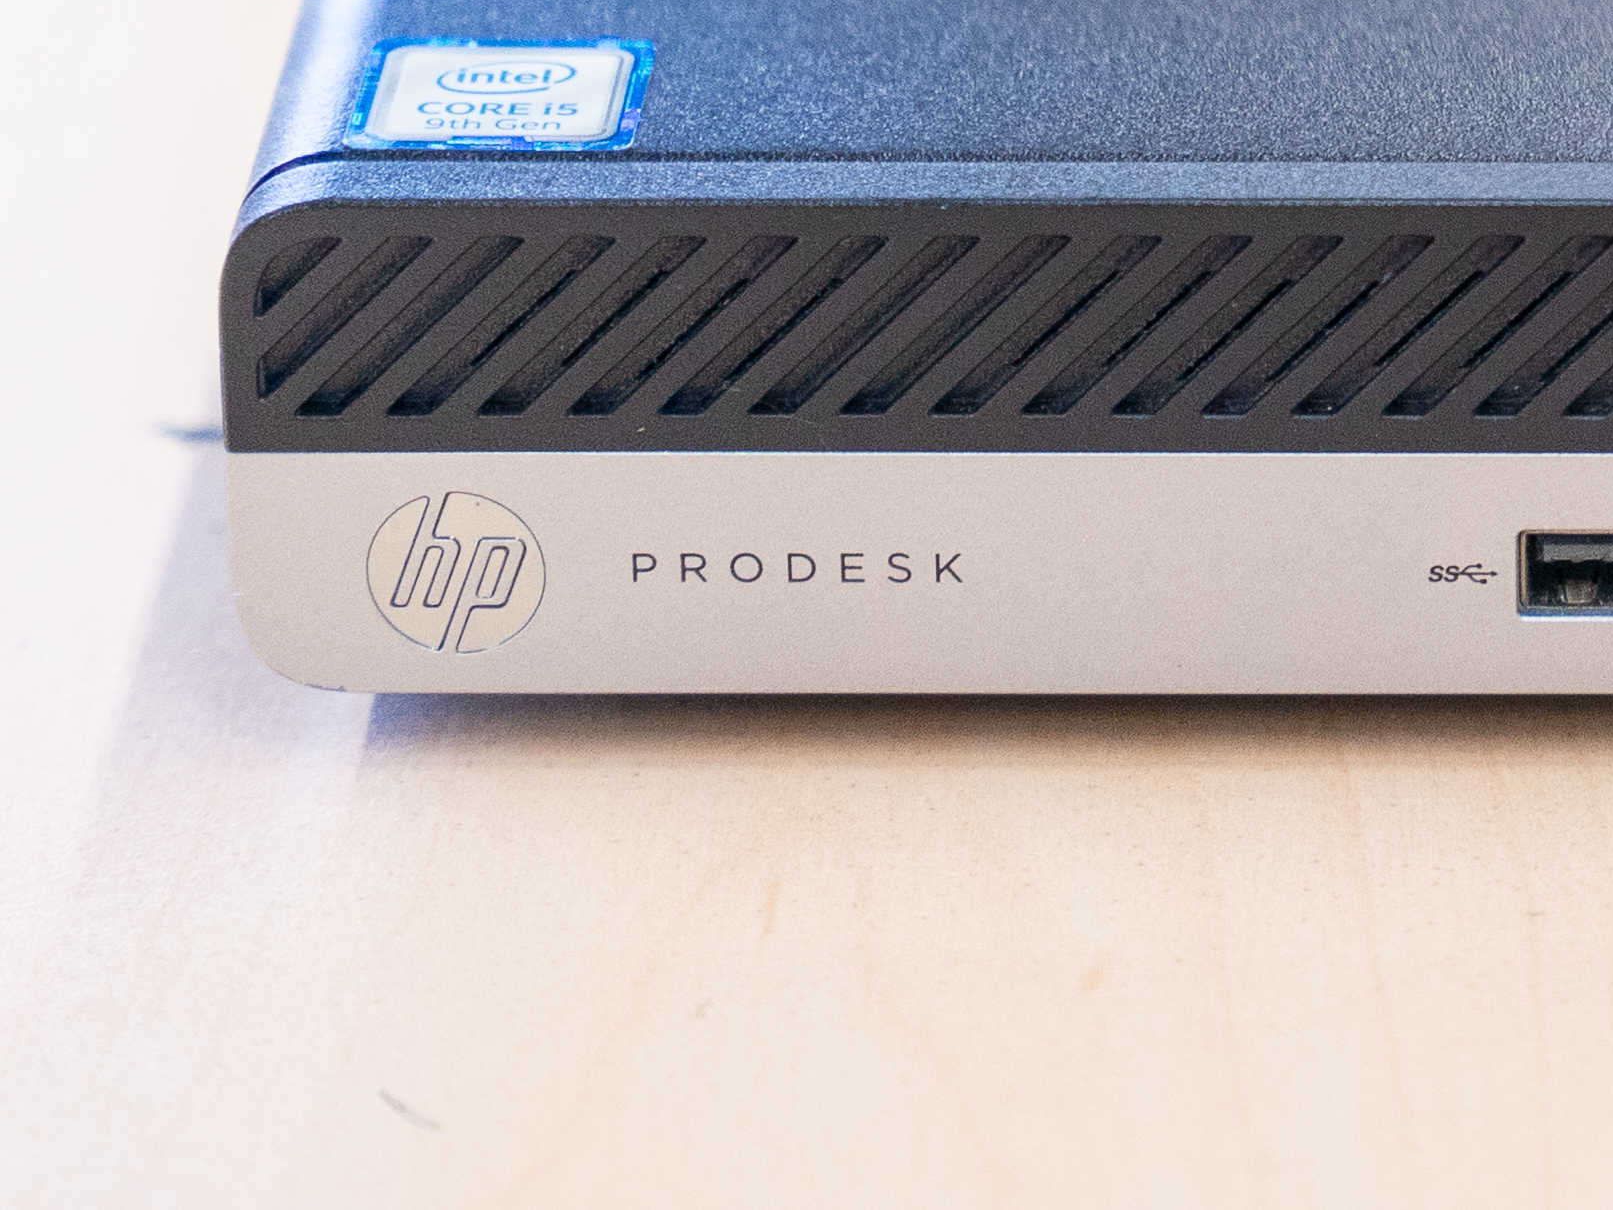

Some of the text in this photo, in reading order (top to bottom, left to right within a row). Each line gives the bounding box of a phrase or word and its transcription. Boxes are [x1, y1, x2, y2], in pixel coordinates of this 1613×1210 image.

[456, 68, 552, 84] intel
[416, 101, 579, 116] CORE i5
[425, 117, 562, 131] 9th Gen
[390, 491, 527, 654] hp
[631, 552, 964, 584] PRODESK
